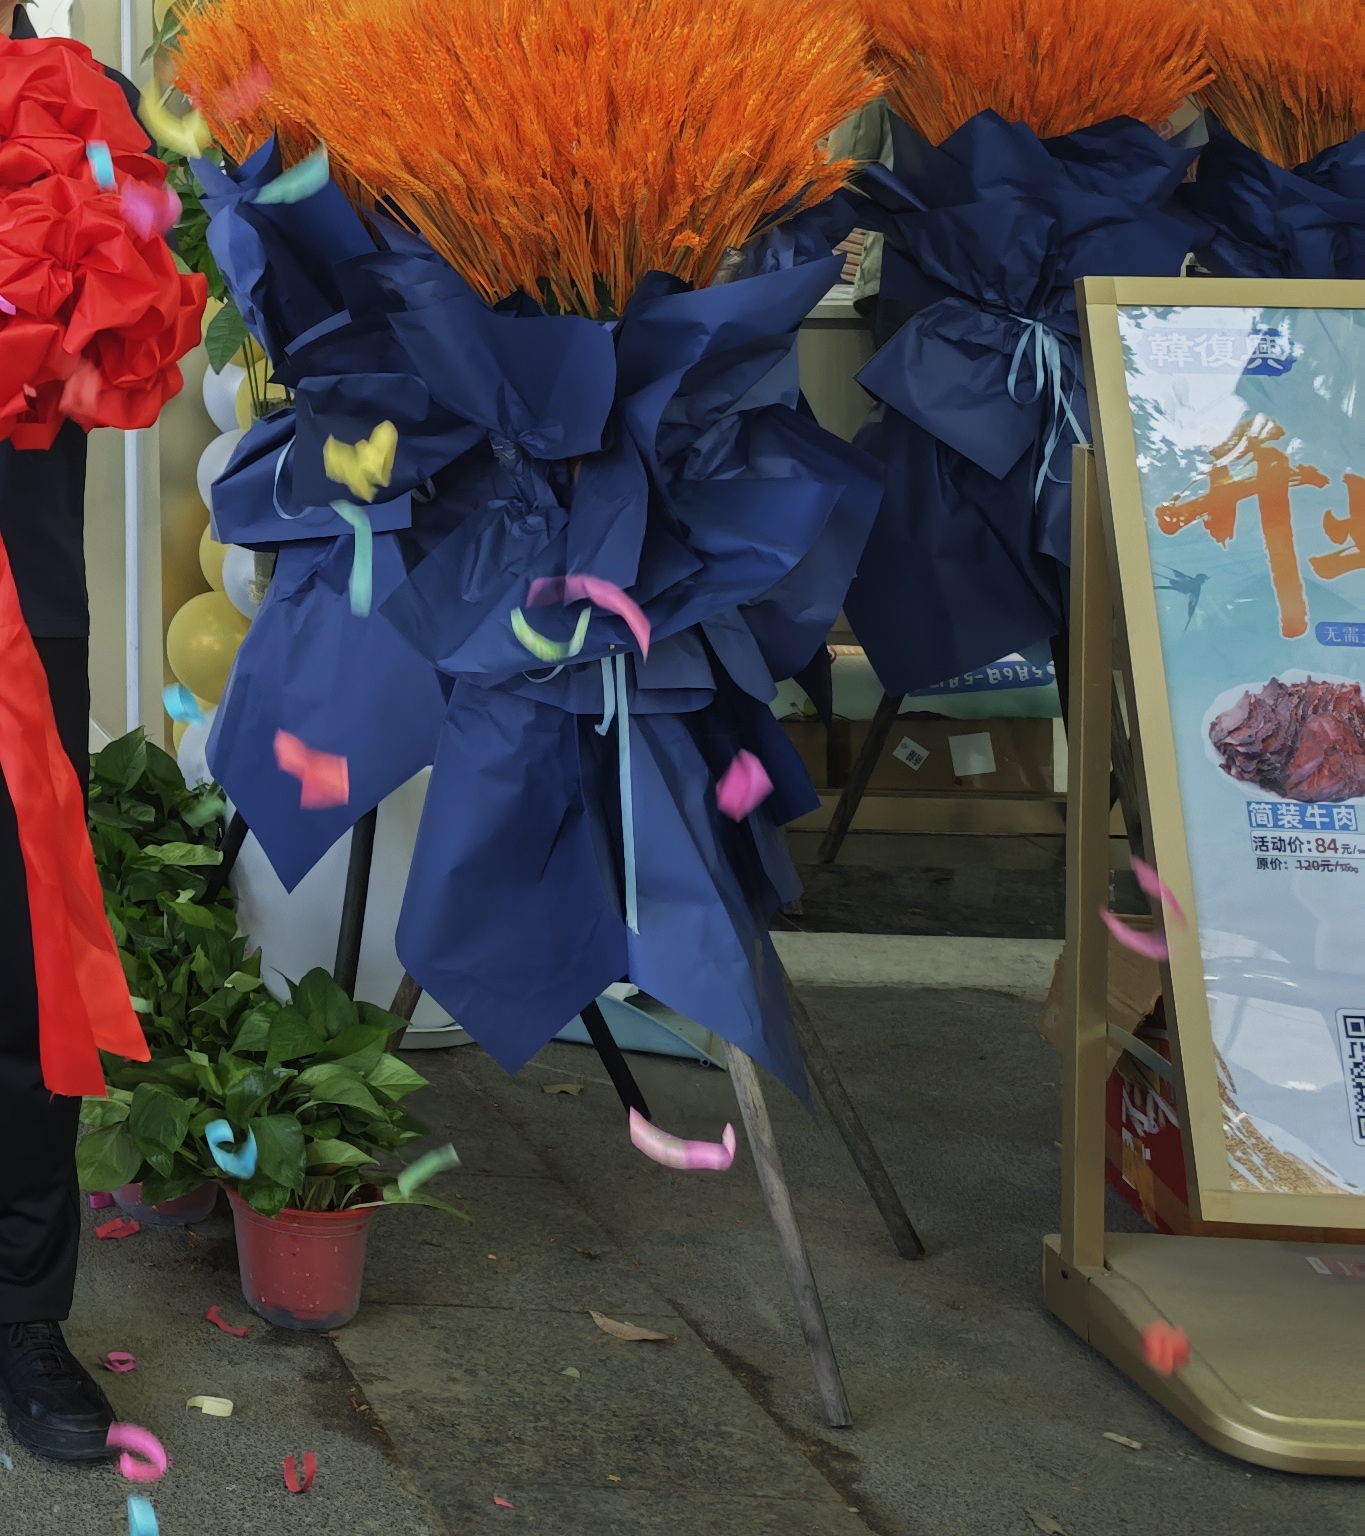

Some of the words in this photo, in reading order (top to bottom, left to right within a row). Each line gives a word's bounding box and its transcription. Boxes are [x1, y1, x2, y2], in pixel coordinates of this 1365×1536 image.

[1148, 332, 1290, 370] 韓復興
[1249, 802, 1357, 831] 简装牛肉
